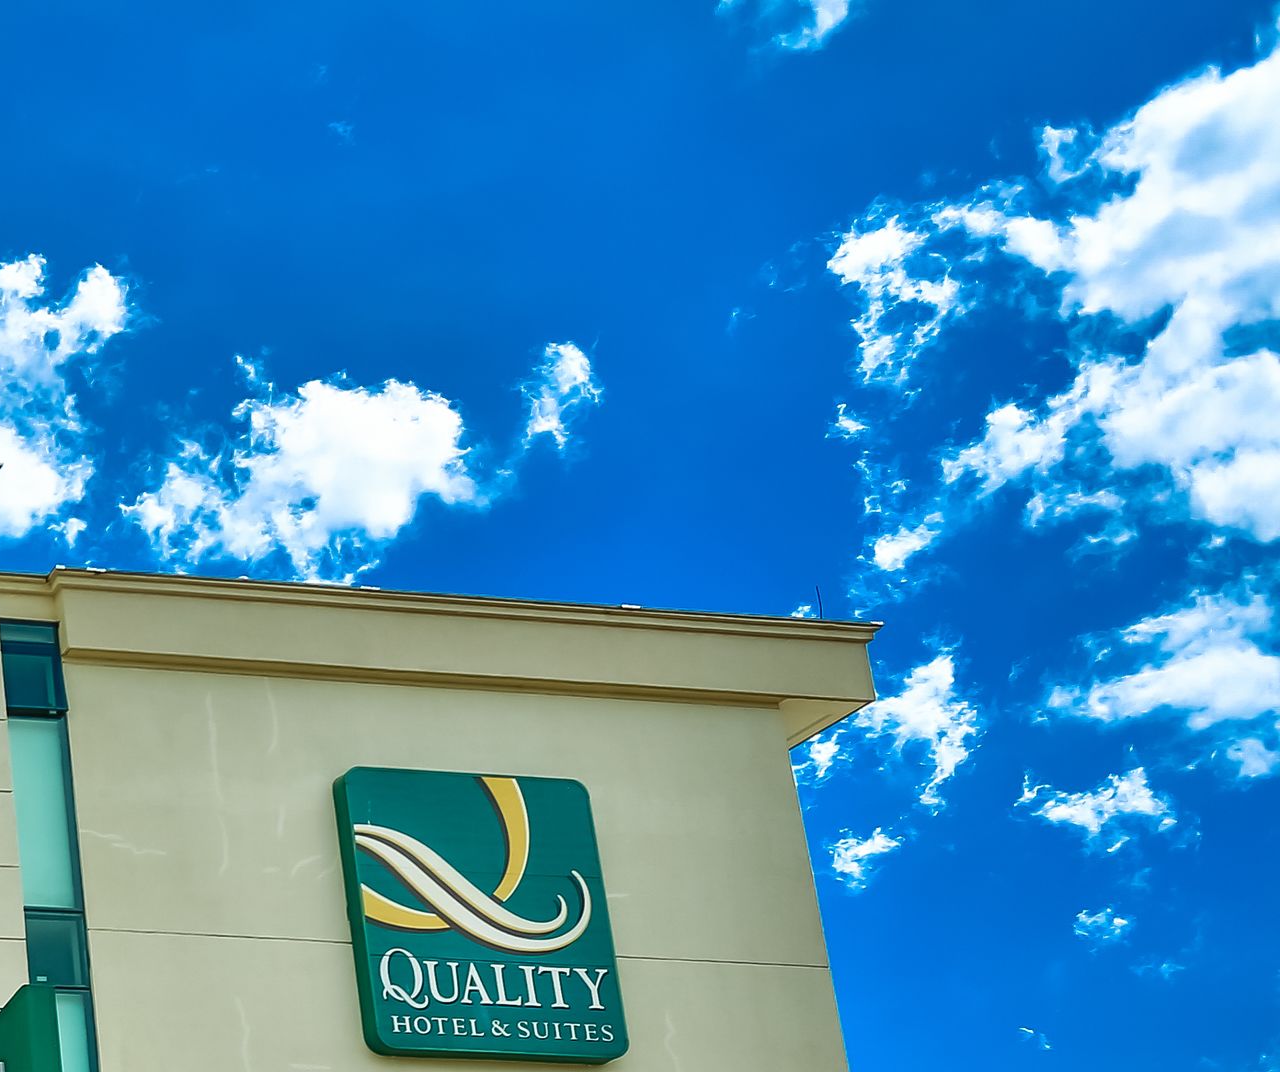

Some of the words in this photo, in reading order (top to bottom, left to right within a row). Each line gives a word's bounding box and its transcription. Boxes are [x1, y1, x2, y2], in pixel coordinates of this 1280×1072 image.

[378, 948, 608, 1010] QUALITY
[391, 1015, 484, 1037] HOTEL
[491, 1020, 511, 1037] &
[517, 1021, 614, 1042] SUITES
